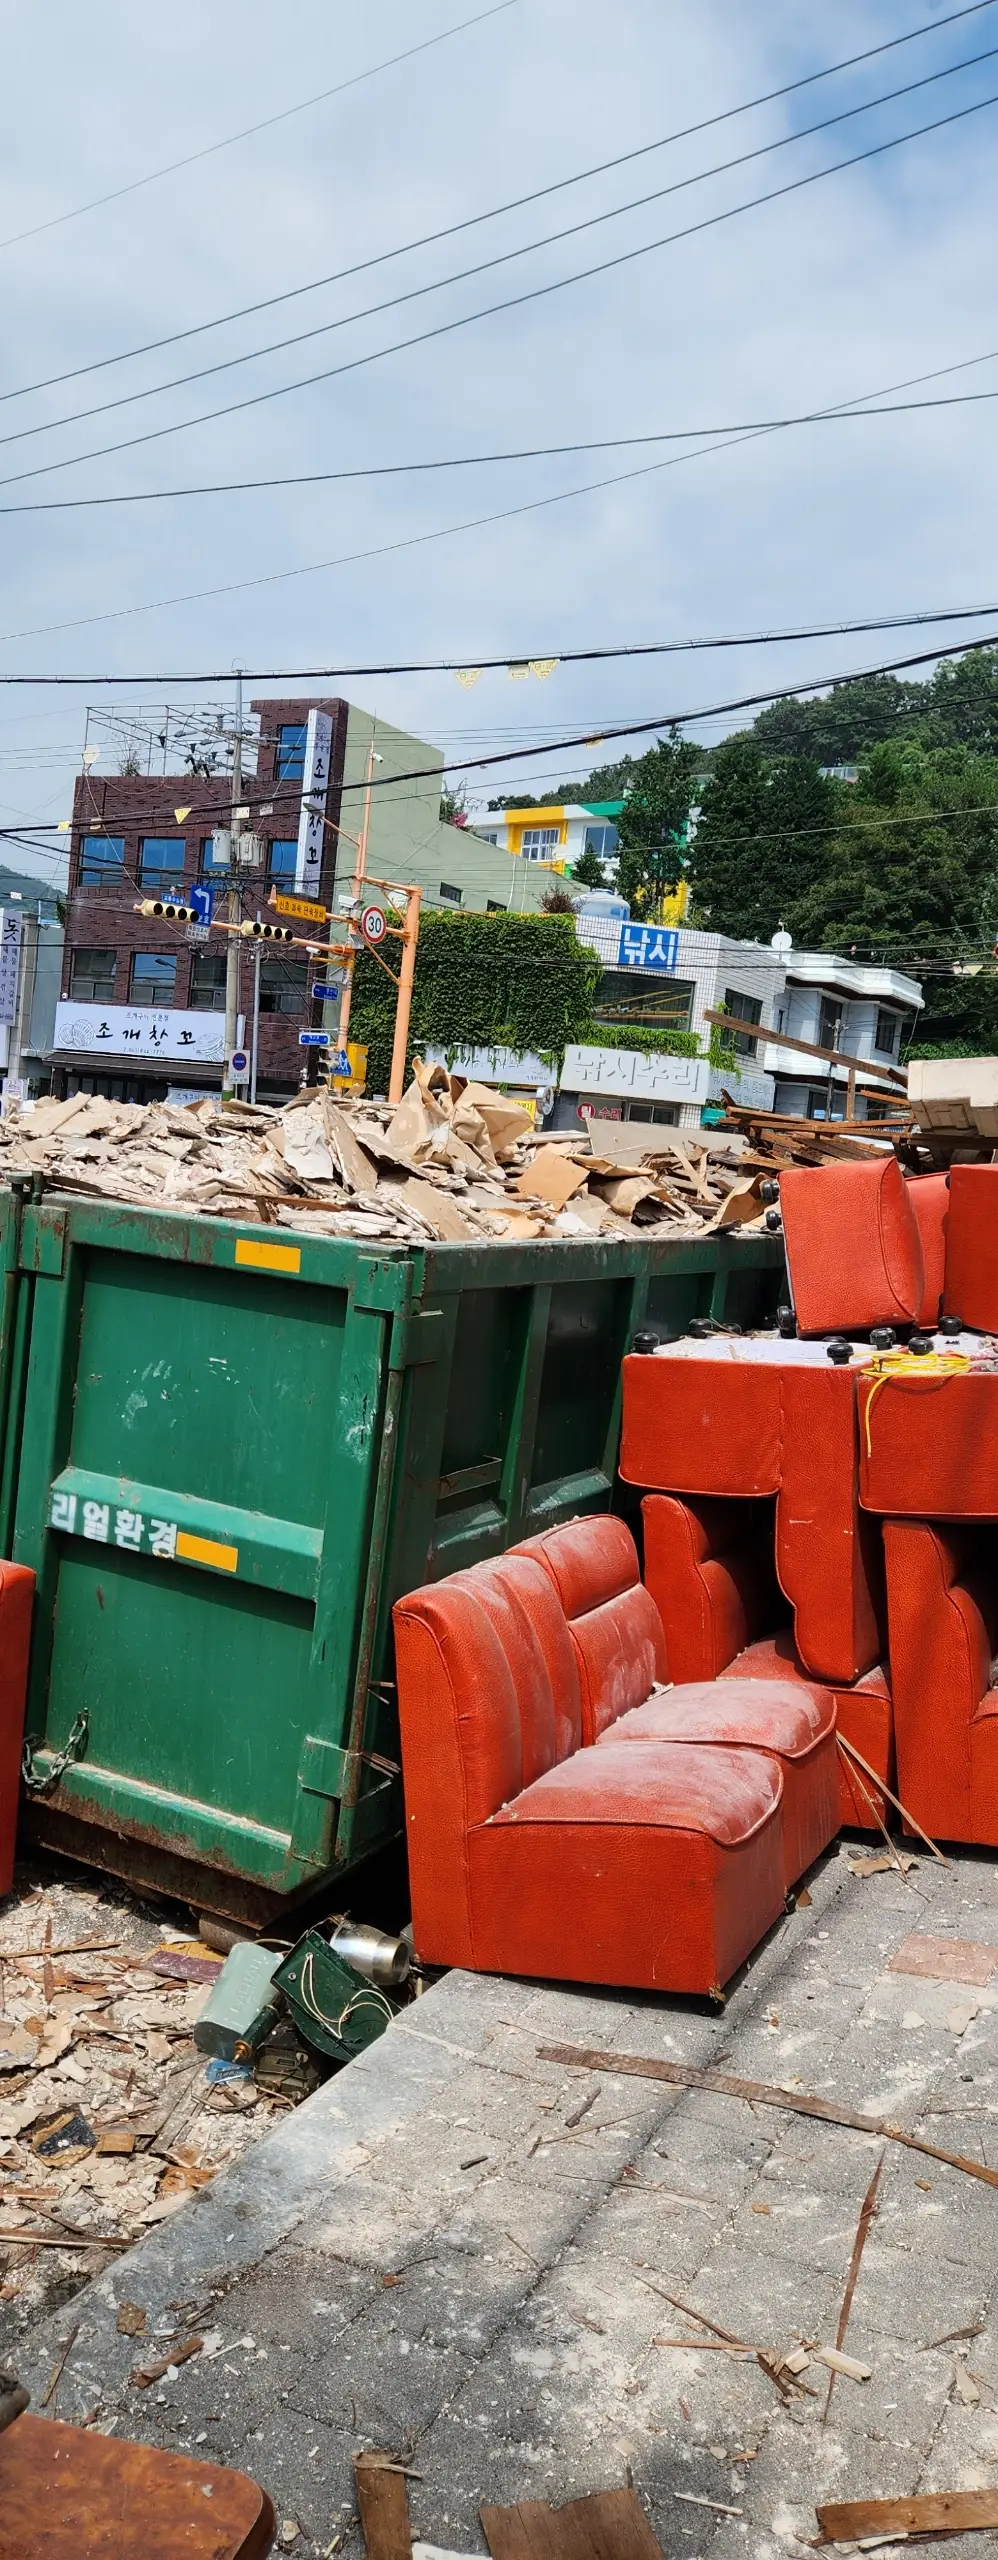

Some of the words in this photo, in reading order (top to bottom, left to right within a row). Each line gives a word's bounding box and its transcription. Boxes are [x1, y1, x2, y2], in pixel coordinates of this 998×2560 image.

[279, 900, 290, 911] 신호
[368, 916, 382, 934] 30
[624, 929, 675, 970] 낚시
[125, 1012, 149, 1021] 조개구이
[95, 1022, 196, 1047] 조개창꼬
[573, 1051, 701, 1093] 낚시수리
[599, 1106, 622, 1121] 수리
[51, 1493, 177, 1559] 리얼환경
